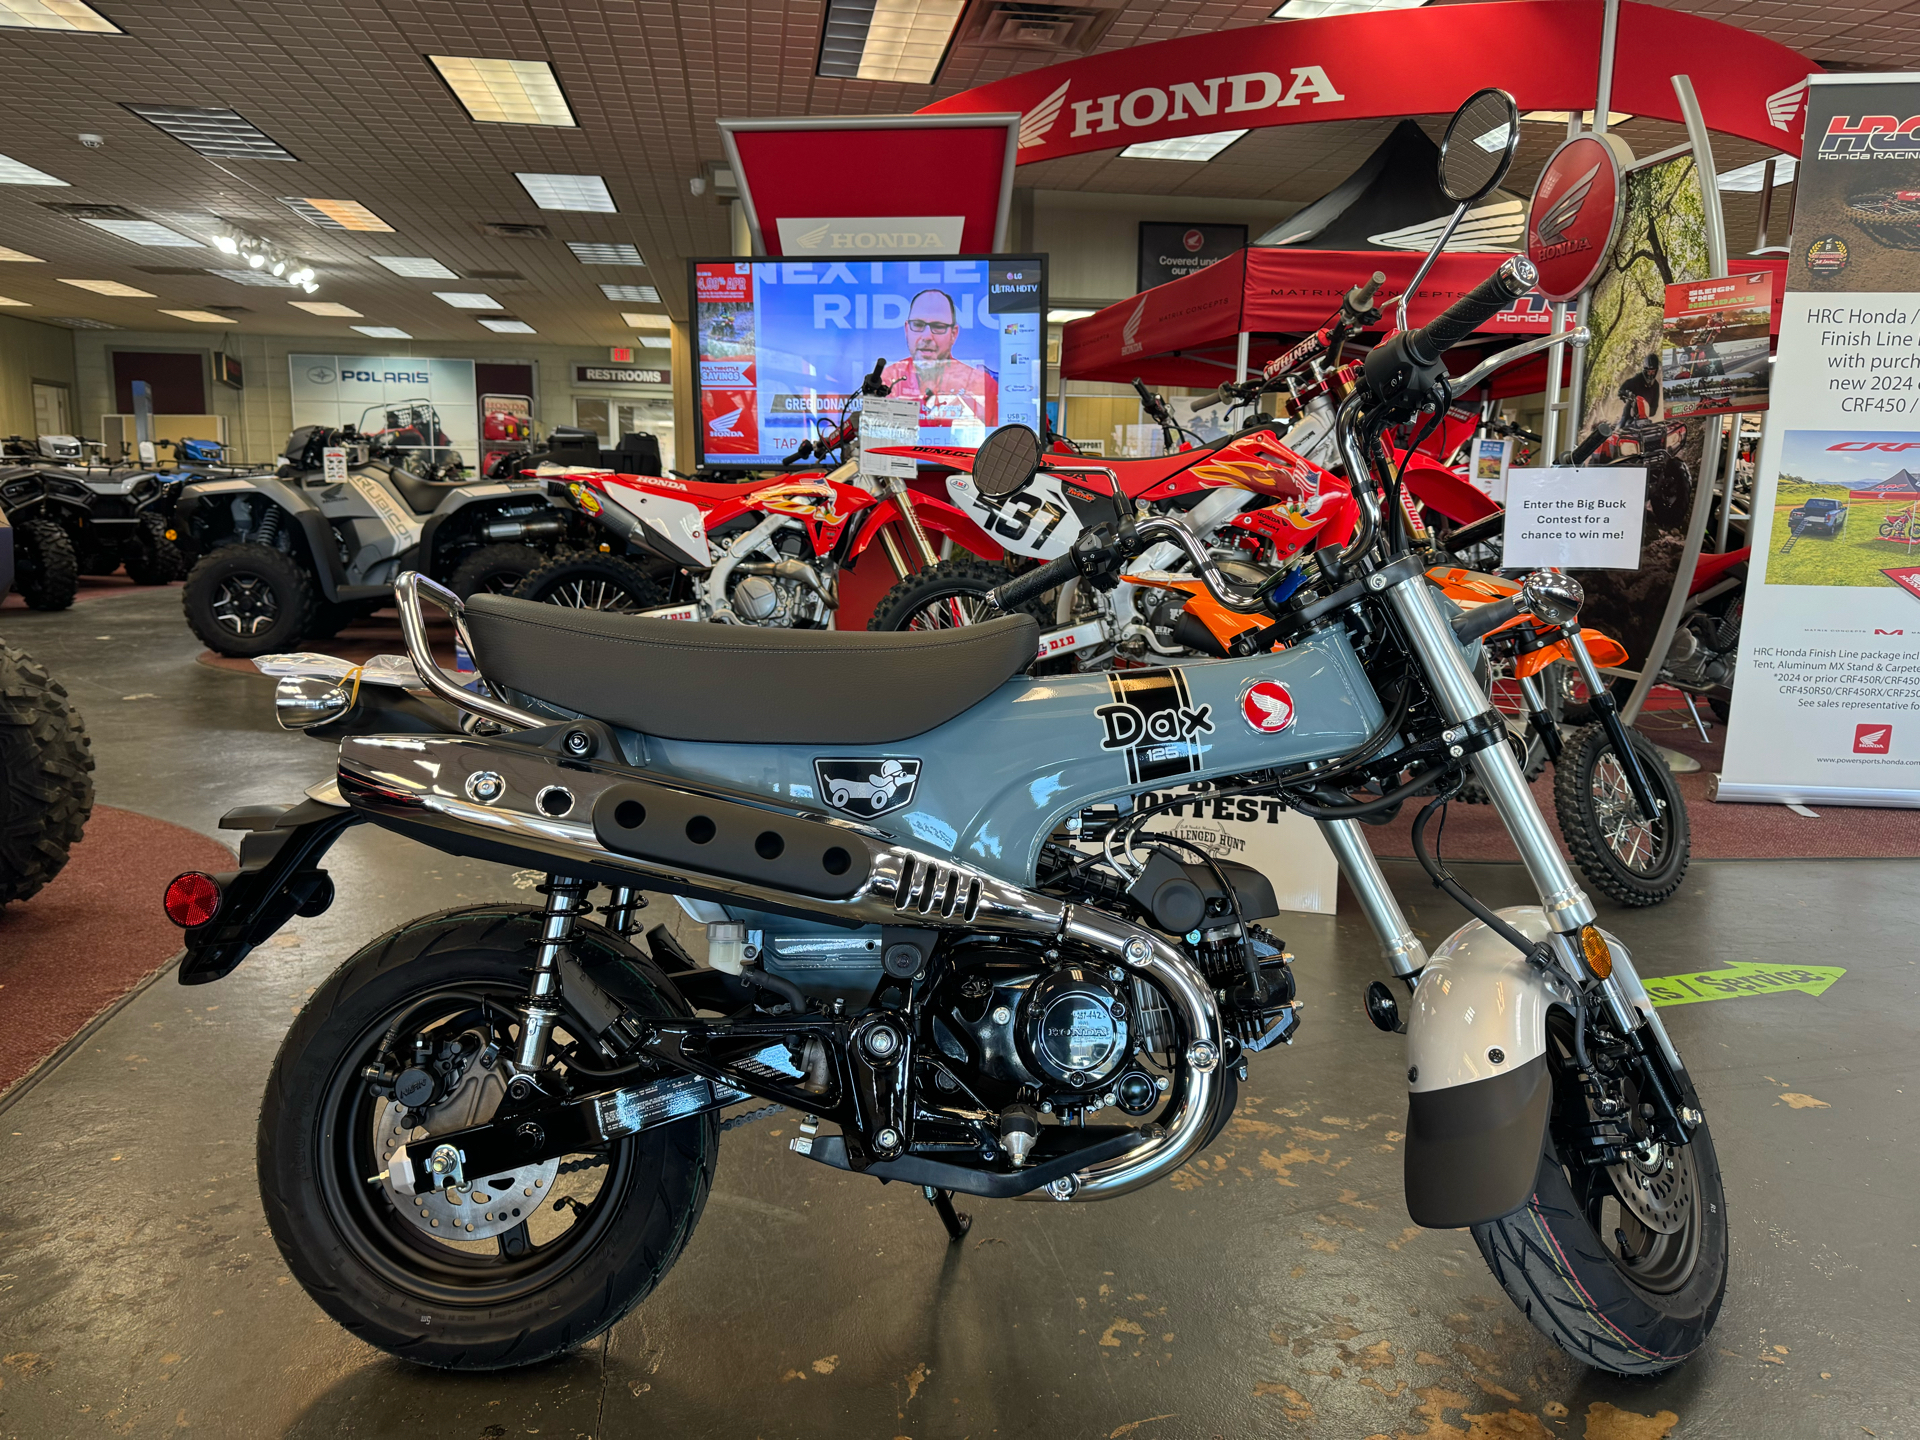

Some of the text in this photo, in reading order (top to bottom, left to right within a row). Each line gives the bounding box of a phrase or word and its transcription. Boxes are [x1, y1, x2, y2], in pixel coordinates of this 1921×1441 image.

[1070, 65, 1344, 138] HONDA
[1818, 152, 1920, 160] Honda RACIN
[830, 232, 945, 248] HONDA
[1538, 238, 1592, 262] HONDA
[1159, 256, 1198, 266] Covered
[992, 284, 1038, 293] ULTRA HDTV
[1374, 290, 1467, 298] ONEPTS
[1689, 285, 1735, 296] SLEIGH
[1689, 294, 1715, 302] THE
[1689, 295, 1756, 309] HOLIDAYS
[1158, 298, 1229, 322] MATRIX CONCEPTS
[1807, 309, 1844, 324] HRC
[1849, 308, 1906, 324] Honda
[1496, 314, 1549, 322] Honda
[1821, 331, 1912, 346] Finish Line
[614, 348, 630, 360] EXIT
[1121, 342, 1143, 356] HONDA
[1828, 354, 1865, 368] with
[341, 369, 429, 384] POLARIS
[586, 368, 661, 383] RESTROOMS
[702, 372, 740, 381] SAVINGS
[1829, 376, 1913, 390] new 2024
[486, 402, 527, 410] HONDA
[785, 398, 812, 410] GREG
[1841, 398, 1906, 413] CRF450
[773, 438, 797, 449] TAP
[636, 475, 688, 491] HONDA
[1400, 484, 1423, 530] SHOWA
[1523, 500, 1626, 510] Enter the Big Buck
[1257, 511, 1281, 525] HONDA
[1537, 515, 1582, 524] Contest
[1584, 515, 1600, 524] for
[1258, 519, 1280, 532] Racing
[1521, 531, 1562, 540] chance
[1579, 531, 1599, 539] win
[1602, 530, 1624, 539] me!
[1753, 648, 1773, 656] HRC
[1776, 648, 1806, 657] Honda
[1809, 649, 1836, 658] Finish
[1839, 650, 1859, 658] Line
[1861, 650, 1900, 660] package
[1753, 660, 1775, 669] Tent,
[1777, 661, 1826, 670] Aluminum
[1829, 662, 1844, 670] MX
[1847, 663, 1874, 671] Stand
[1815, 674, 1838, 684] prior
[1798, 699, 1815, 708] See
[1817, 699, 1839, 708] sales
[1841, 700, 1908, 710] representative
[1094, 702, 1216, 752] Dax
[1147, 746, 1180, 762] 125
[1817, 758, 1920, 766] www.powersports.honda.com
[1138, 792, 1286, 824] ONTEST
[1220, 834, 1246, 851] HUNT
[1694, 970, 1826, 992] Service
[1048, 1027, 1110, 1037] HONDA
